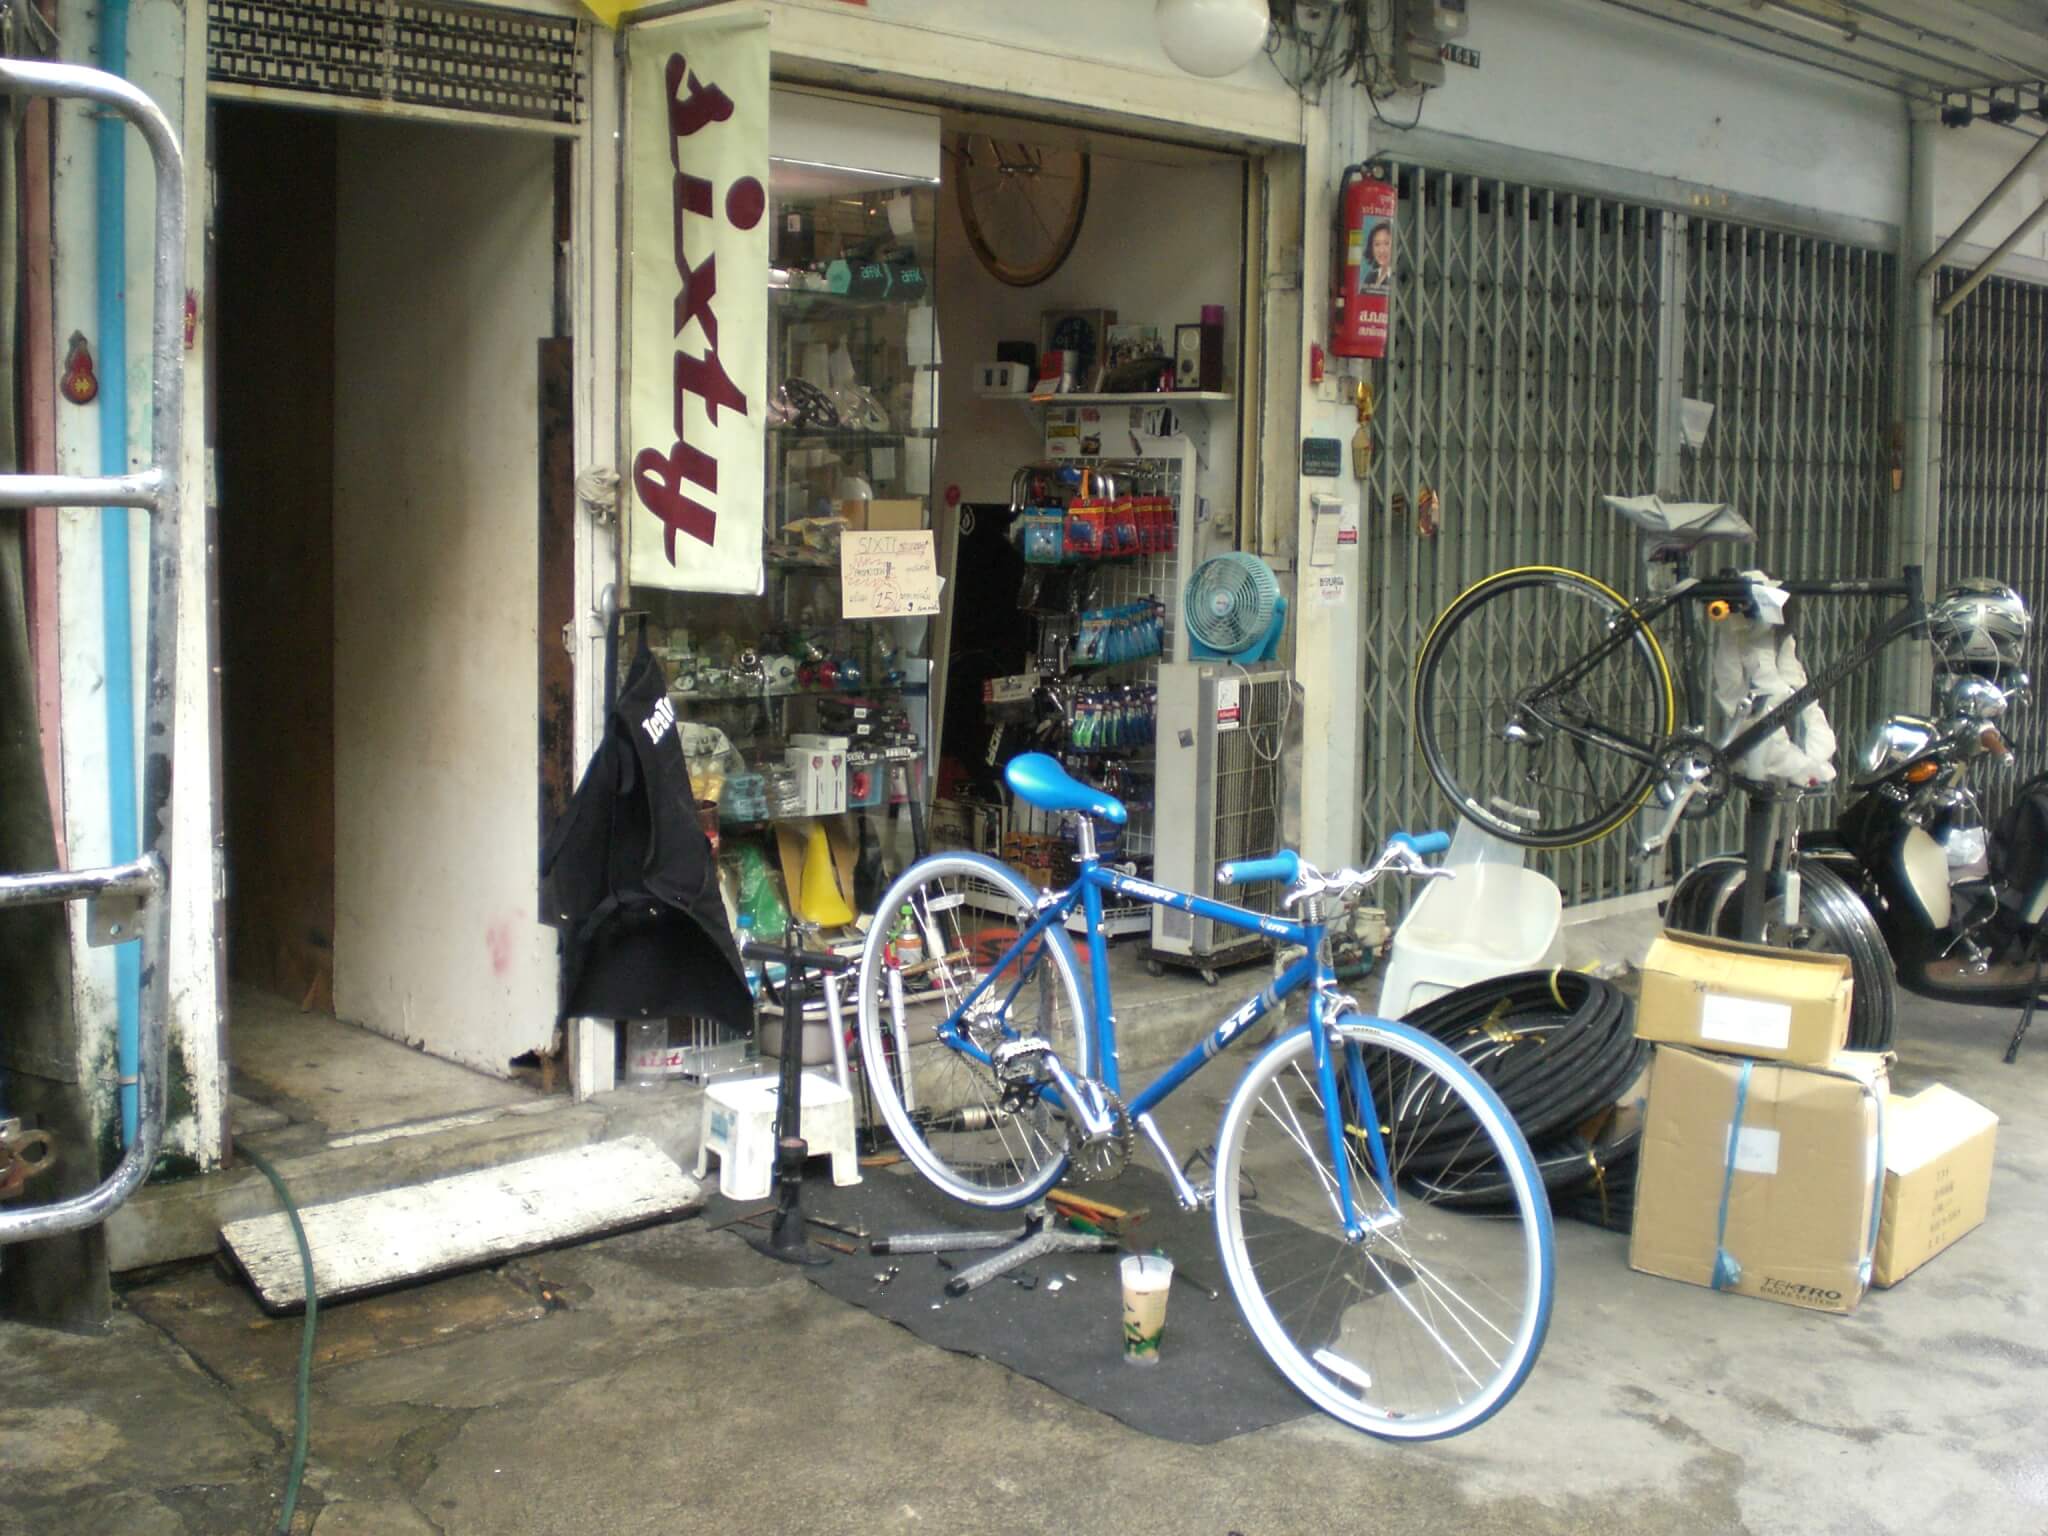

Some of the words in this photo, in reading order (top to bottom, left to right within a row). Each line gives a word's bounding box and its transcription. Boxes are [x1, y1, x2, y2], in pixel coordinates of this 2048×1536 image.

[633, 52, 766, 567] sixty
[1218, 995, 1260, 1042] SE
[1761, 1276, 1842, 1301] TEKTRO
